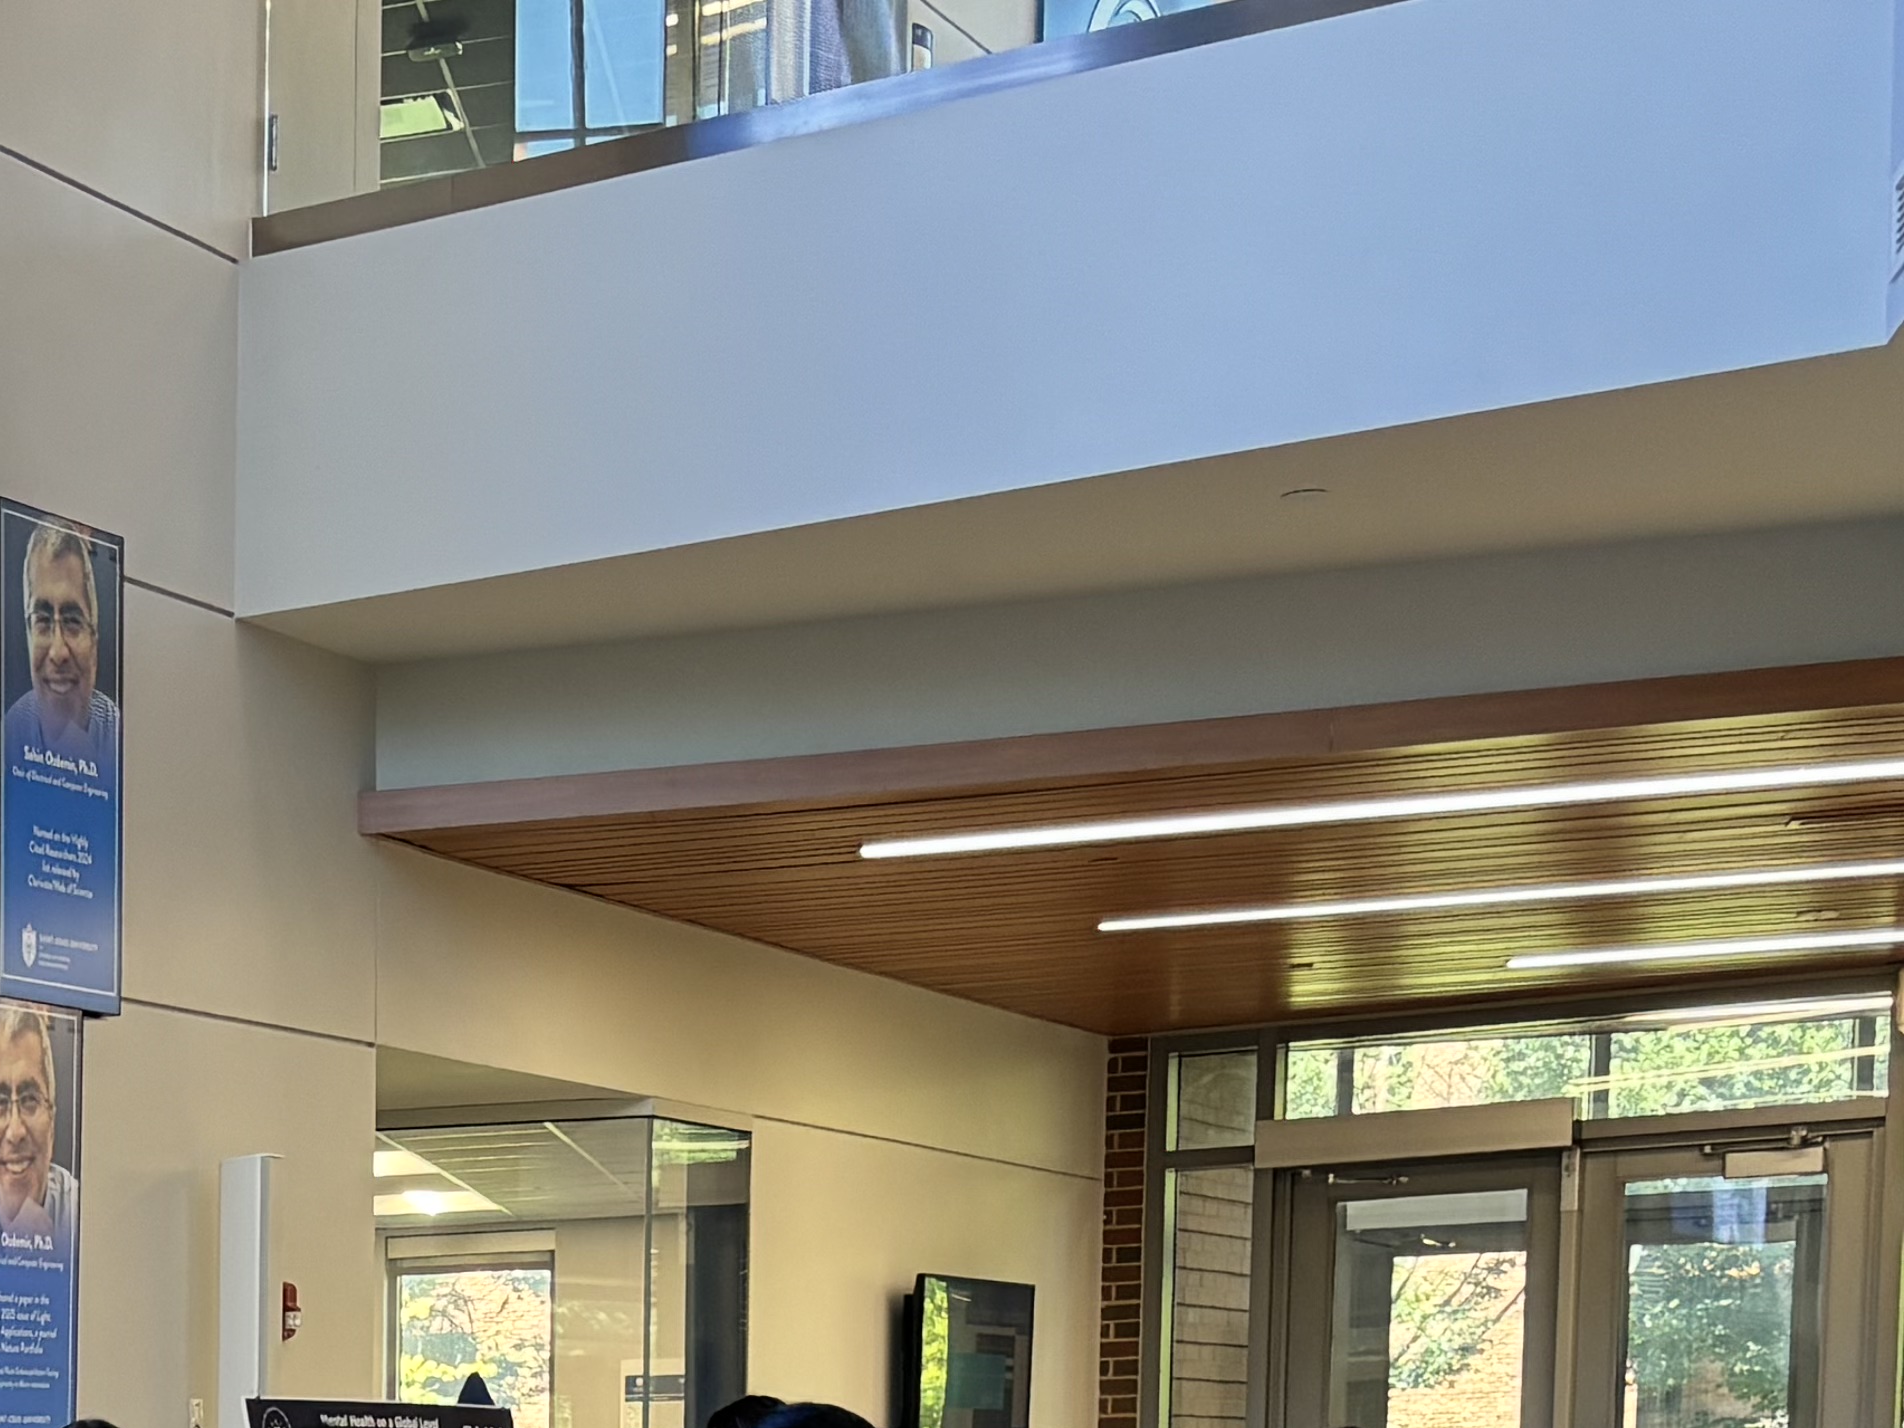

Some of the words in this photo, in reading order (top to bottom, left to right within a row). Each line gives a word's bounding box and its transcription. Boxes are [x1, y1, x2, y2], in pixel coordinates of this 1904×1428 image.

[320, 1414, 348, 1426] Mental
[350, 1416, 375, 1427] Health
[377, 1418, 386, 1427] on
[388, 1418, 393, 1428] a
[394, 1416, 418, 1428] Global
